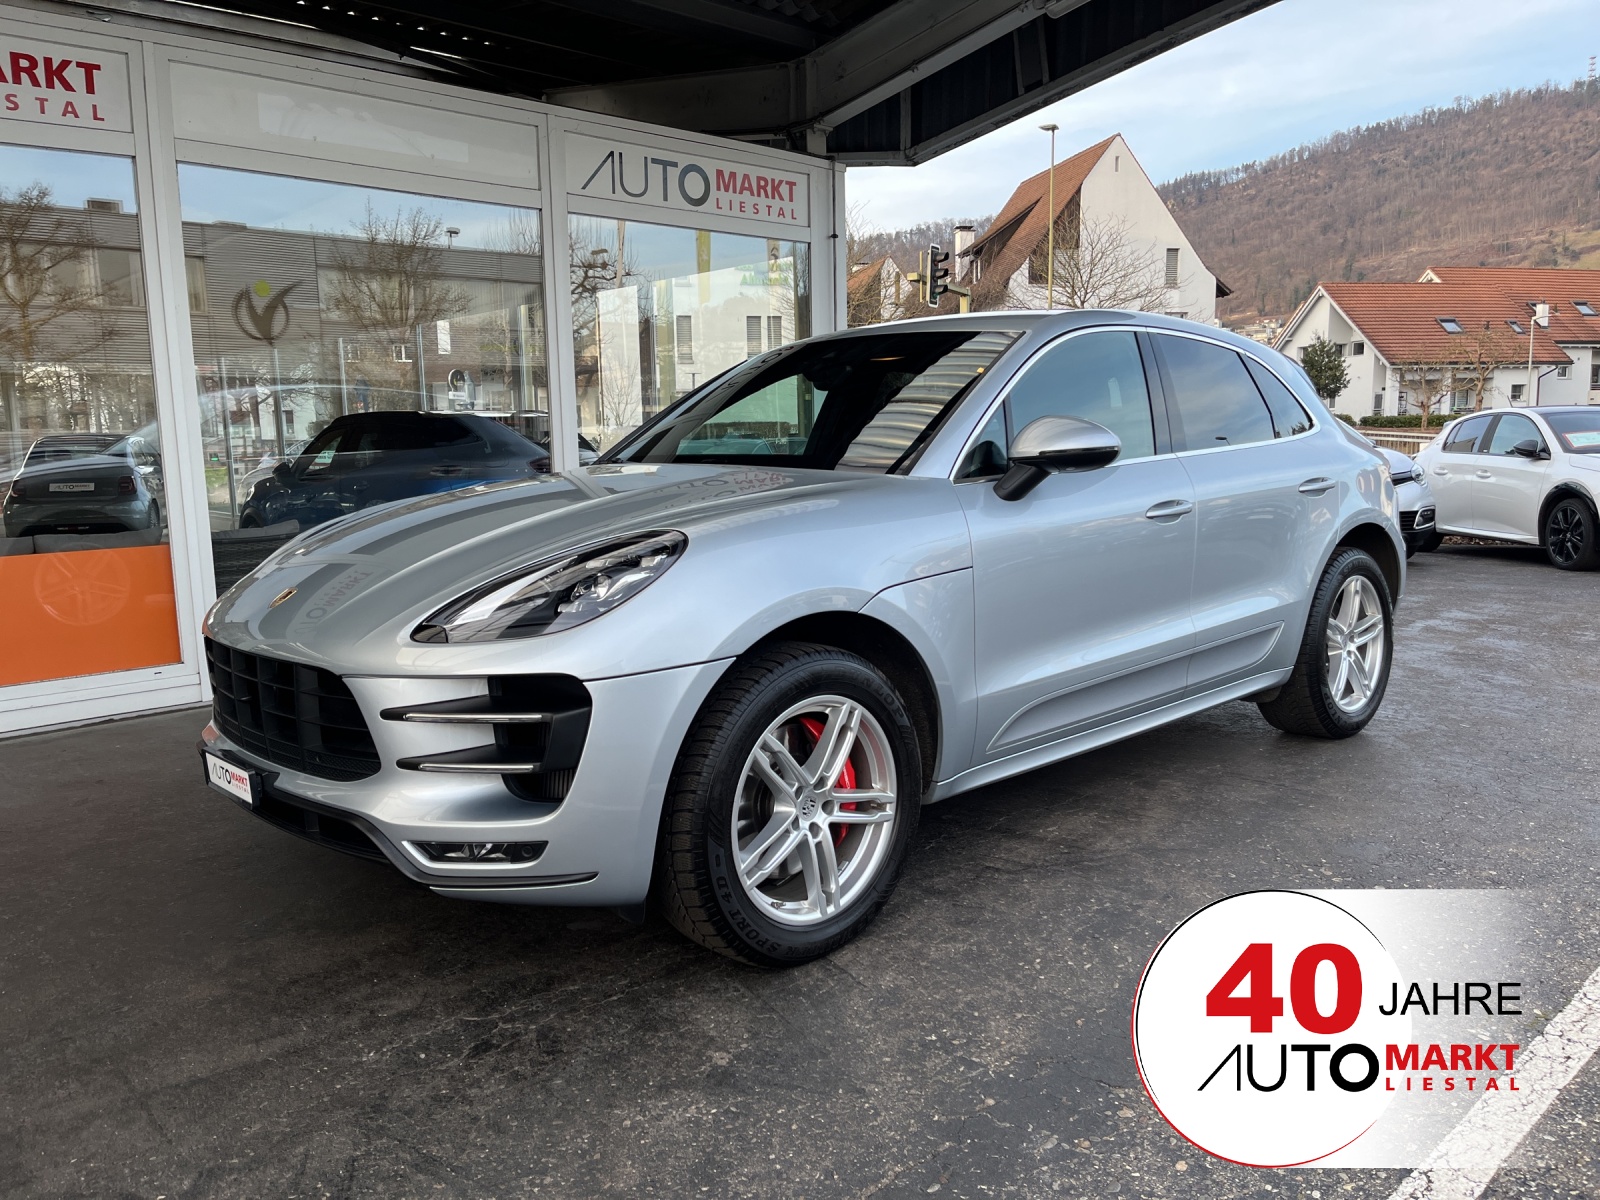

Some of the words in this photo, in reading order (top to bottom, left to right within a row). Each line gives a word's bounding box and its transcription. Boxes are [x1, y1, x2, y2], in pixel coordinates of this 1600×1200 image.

[0, 51, 102, 95] RKT
[581, 150, 711, 207] AUTO
[715, 168, 797, 203] MARKT
[715, 197, 797, 220] LIESTAL
[729, 909, 782, 953] SPORT
